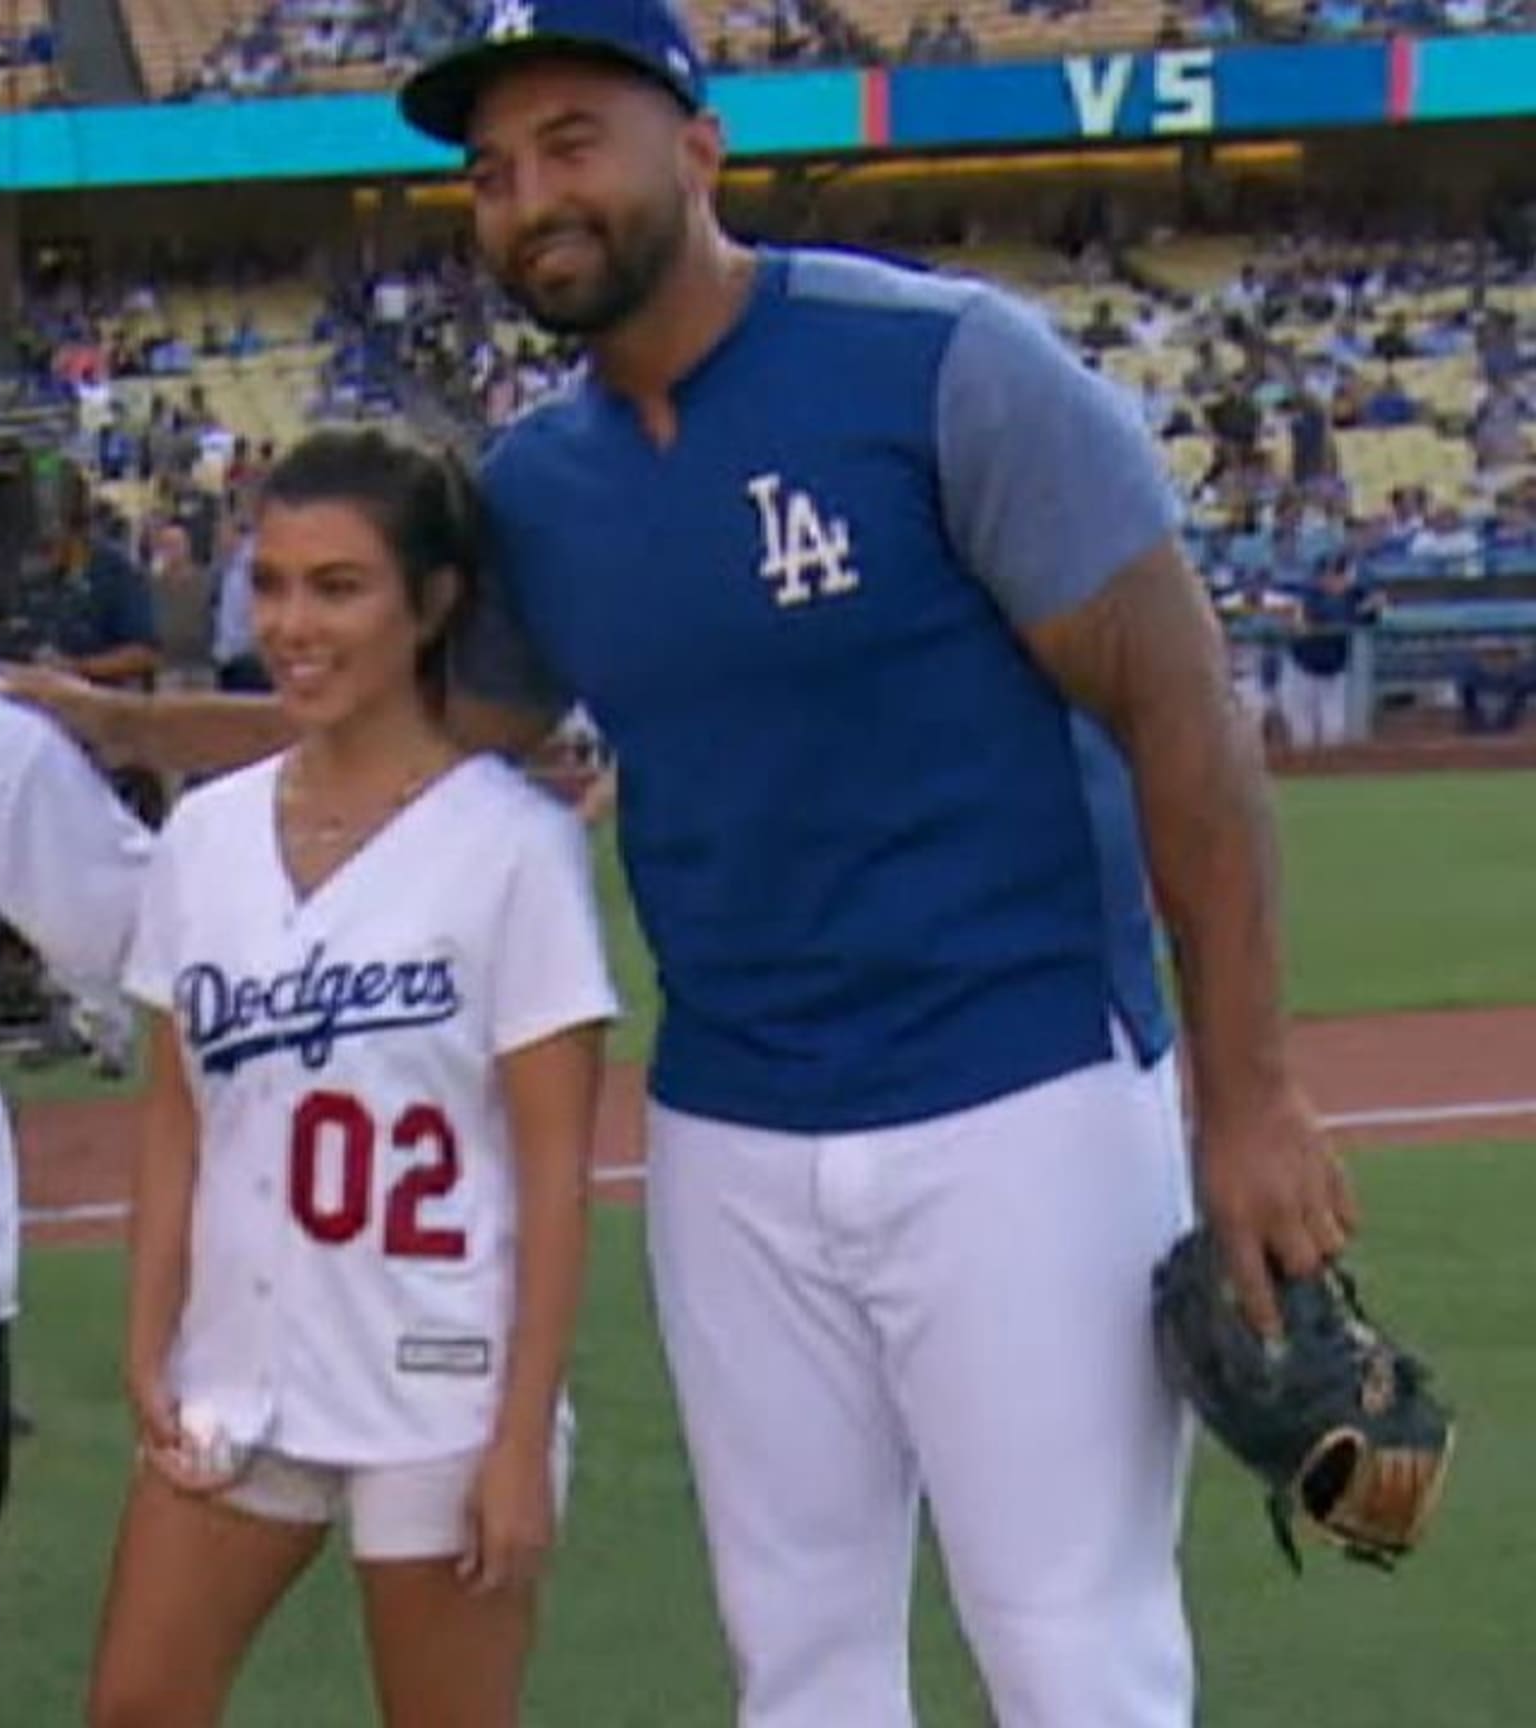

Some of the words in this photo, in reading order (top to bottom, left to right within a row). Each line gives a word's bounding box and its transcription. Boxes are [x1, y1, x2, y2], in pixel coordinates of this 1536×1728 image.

[1065, 50, 1214, 135] VS
[748, 474, 860, 605] LA
[174, 943, 460, 1070] Dodgers
[290, 1091, 466, 1257] 02
